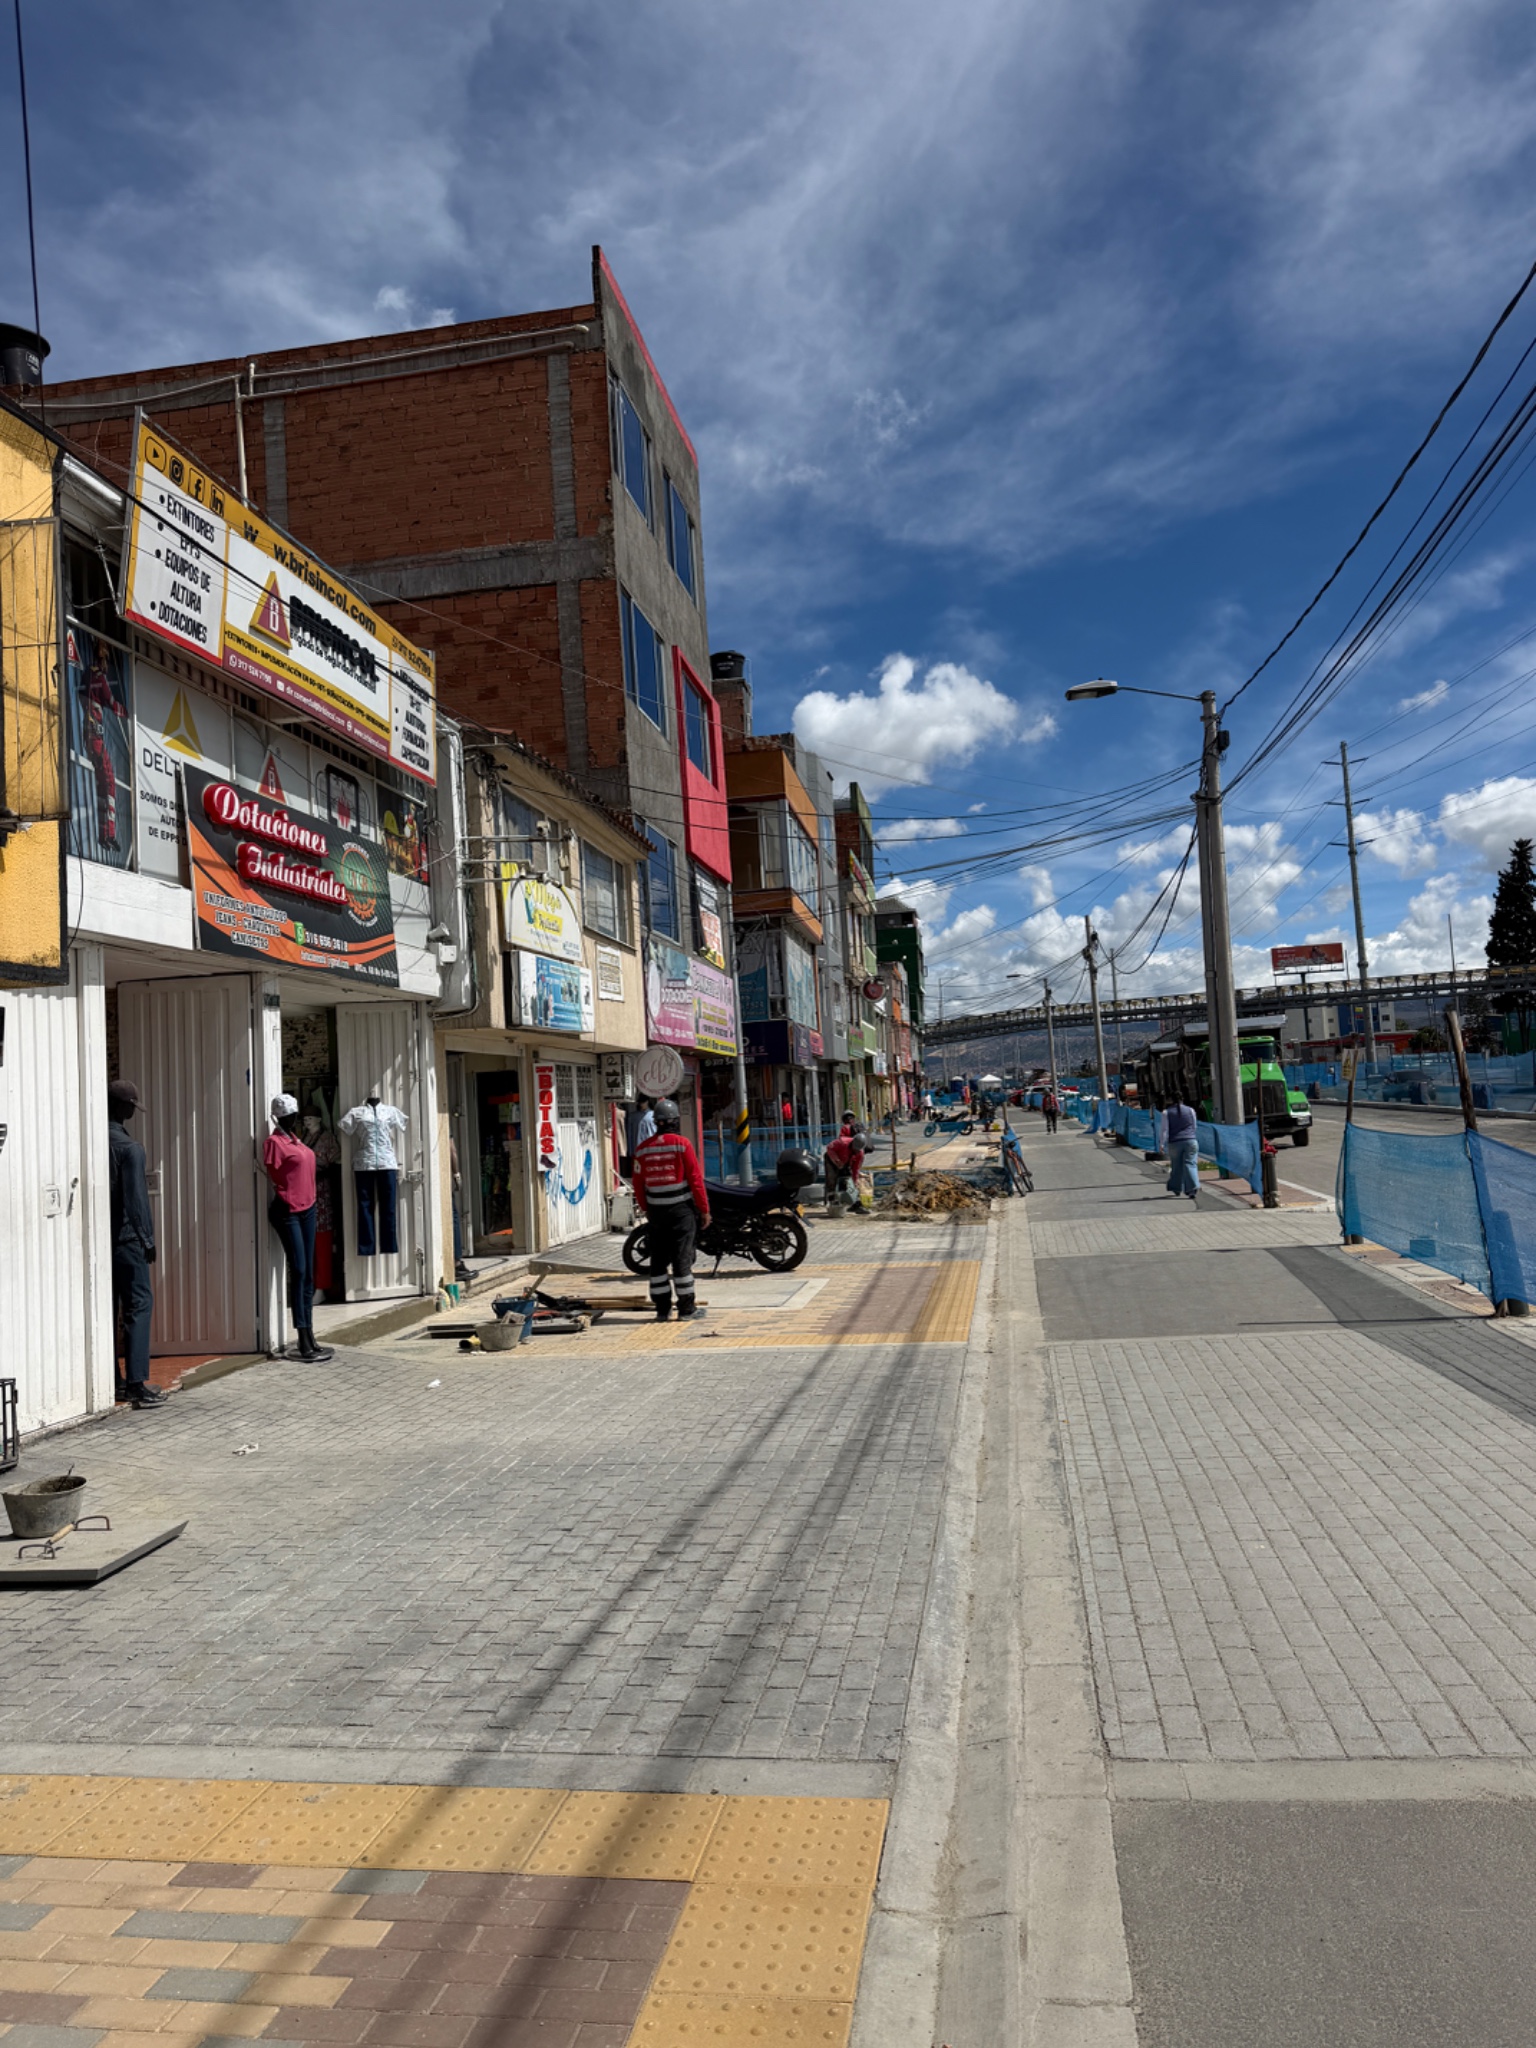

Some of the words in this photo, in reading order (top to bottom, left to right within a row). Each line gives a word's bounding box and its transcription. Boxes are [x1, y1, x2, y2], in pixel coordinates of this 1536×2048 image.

[166, 492, 215, 543] EXTINTORES
[165, 547, 199, 585] EQUIPOS
[200, 570, 211, 594] DE
[170, 580, 202, 615] ALTURA
[158, 600, 208, 644] DOTACIONES
[143, 747, 181, 784] DELT
[140, 789, 168, 808] SOMOS
[214, 785, 328, 855] Dotaciones
[247, 844, 348, 902] Industriales
[538, 1074, 555, 1155] BOTAS
